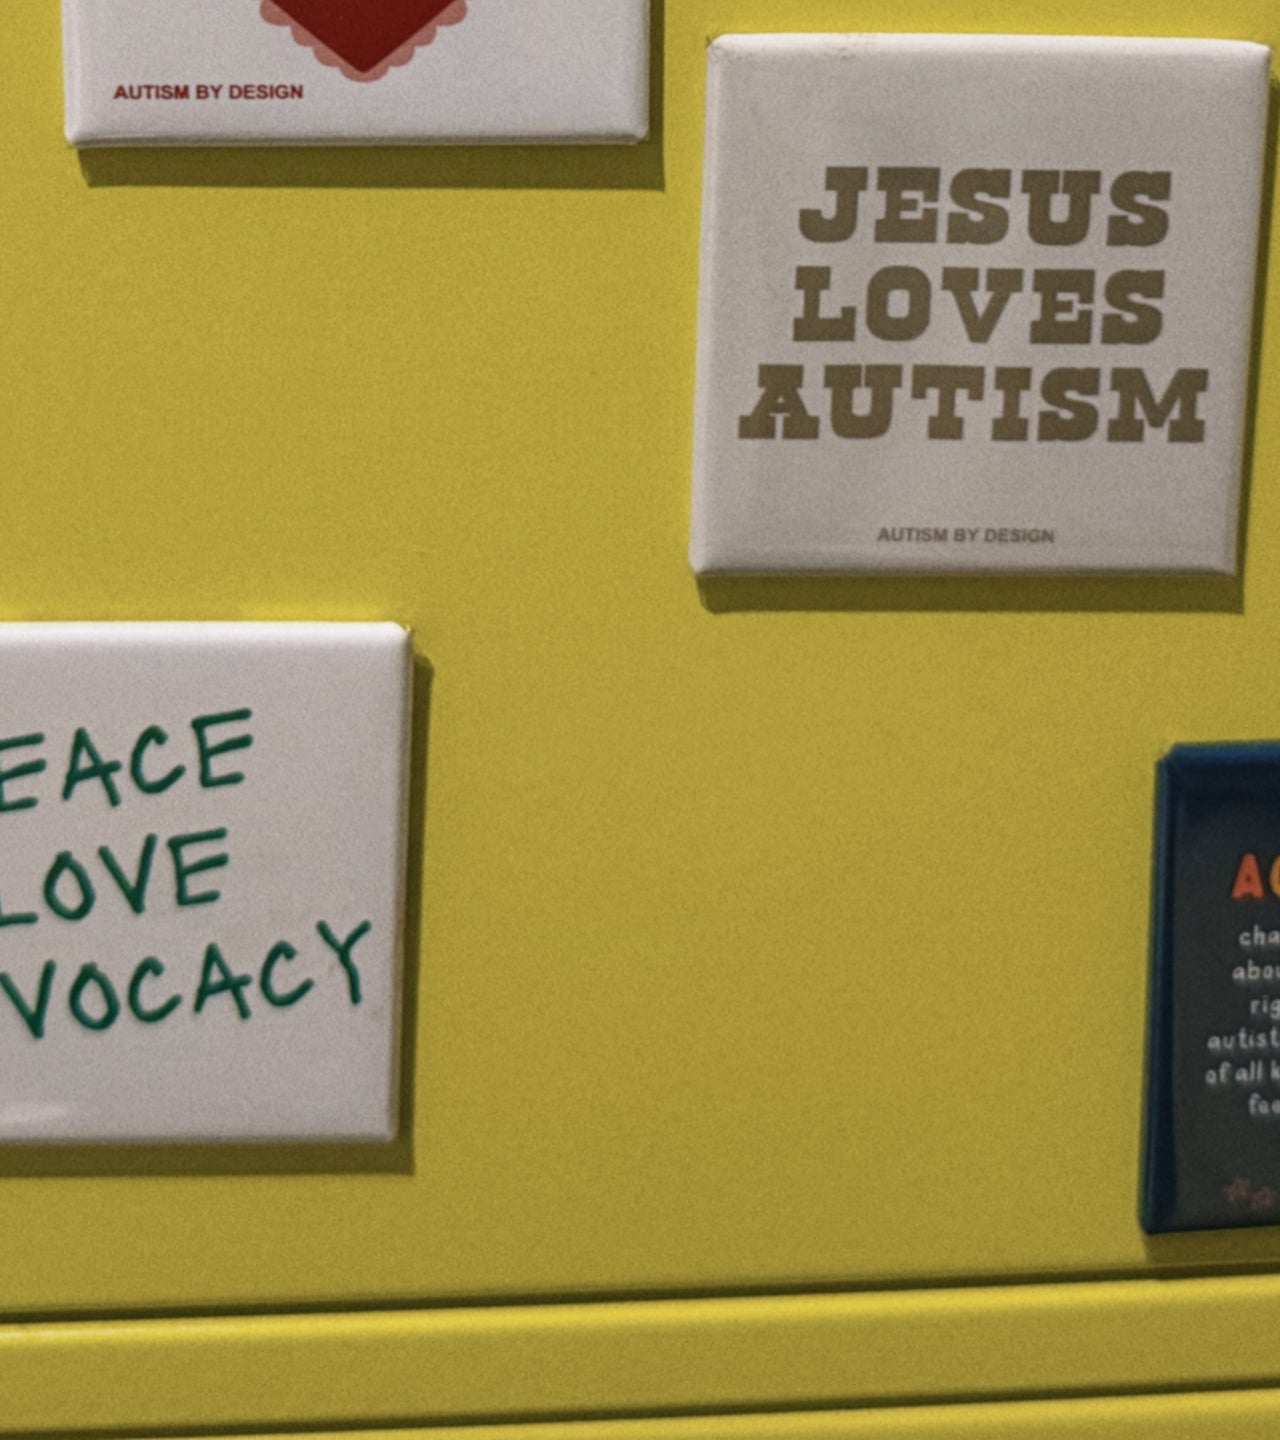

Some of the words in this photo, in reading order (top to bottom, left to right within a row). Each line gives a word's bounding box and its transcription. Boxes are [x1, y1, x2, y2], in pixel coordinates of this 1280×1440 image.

[114, 84, 190, 100] AUTISM
[196, 84, 223, 100] BY
[228, 84, 304, 100] DESIGN
[798, 165, 1172, 248] JESUS
[792, 264, 1166, 346] LOVES
[737, 363, 1210, 444] AUTISM
[877, 528, 948, 543] AUTISM
[954, 528, 980, 543] BY
[984, 528, 1056, 544] DESIGN
[1205, 1061, 1231, 1085] of
[1235, 1059, 1263, 1082] all
